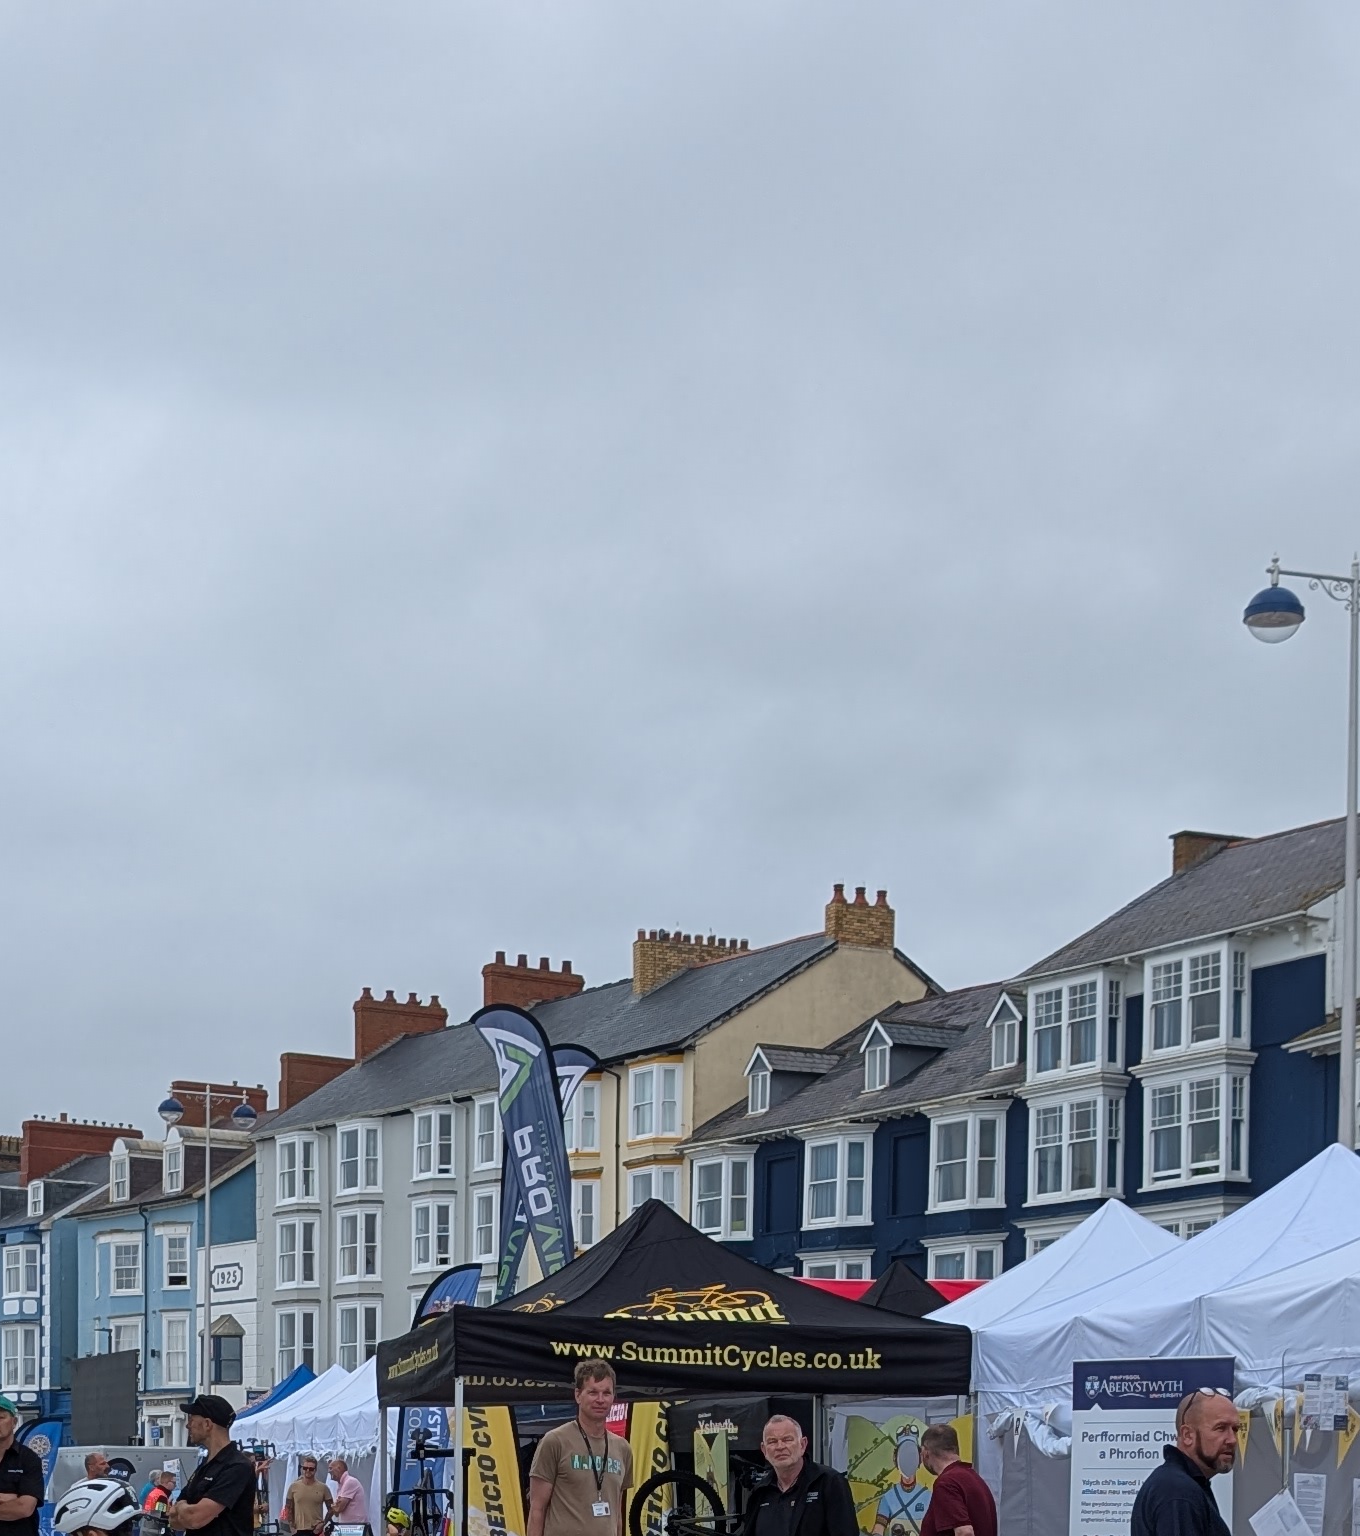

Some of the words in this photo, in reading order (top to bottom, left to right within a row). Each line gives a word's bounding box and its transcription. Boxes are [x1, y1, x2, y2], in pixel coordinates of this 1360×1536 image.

[215, 1270, 238, 1285] 1925
[550, 1342, 882, 1372] www.SummitCycles.co.uk
[1081, 1430, 1150, 1443] Perfformiad
[1099, 1451, 1106, 1459] a
[1109, 1447, 1160, 1460] Phrofion
